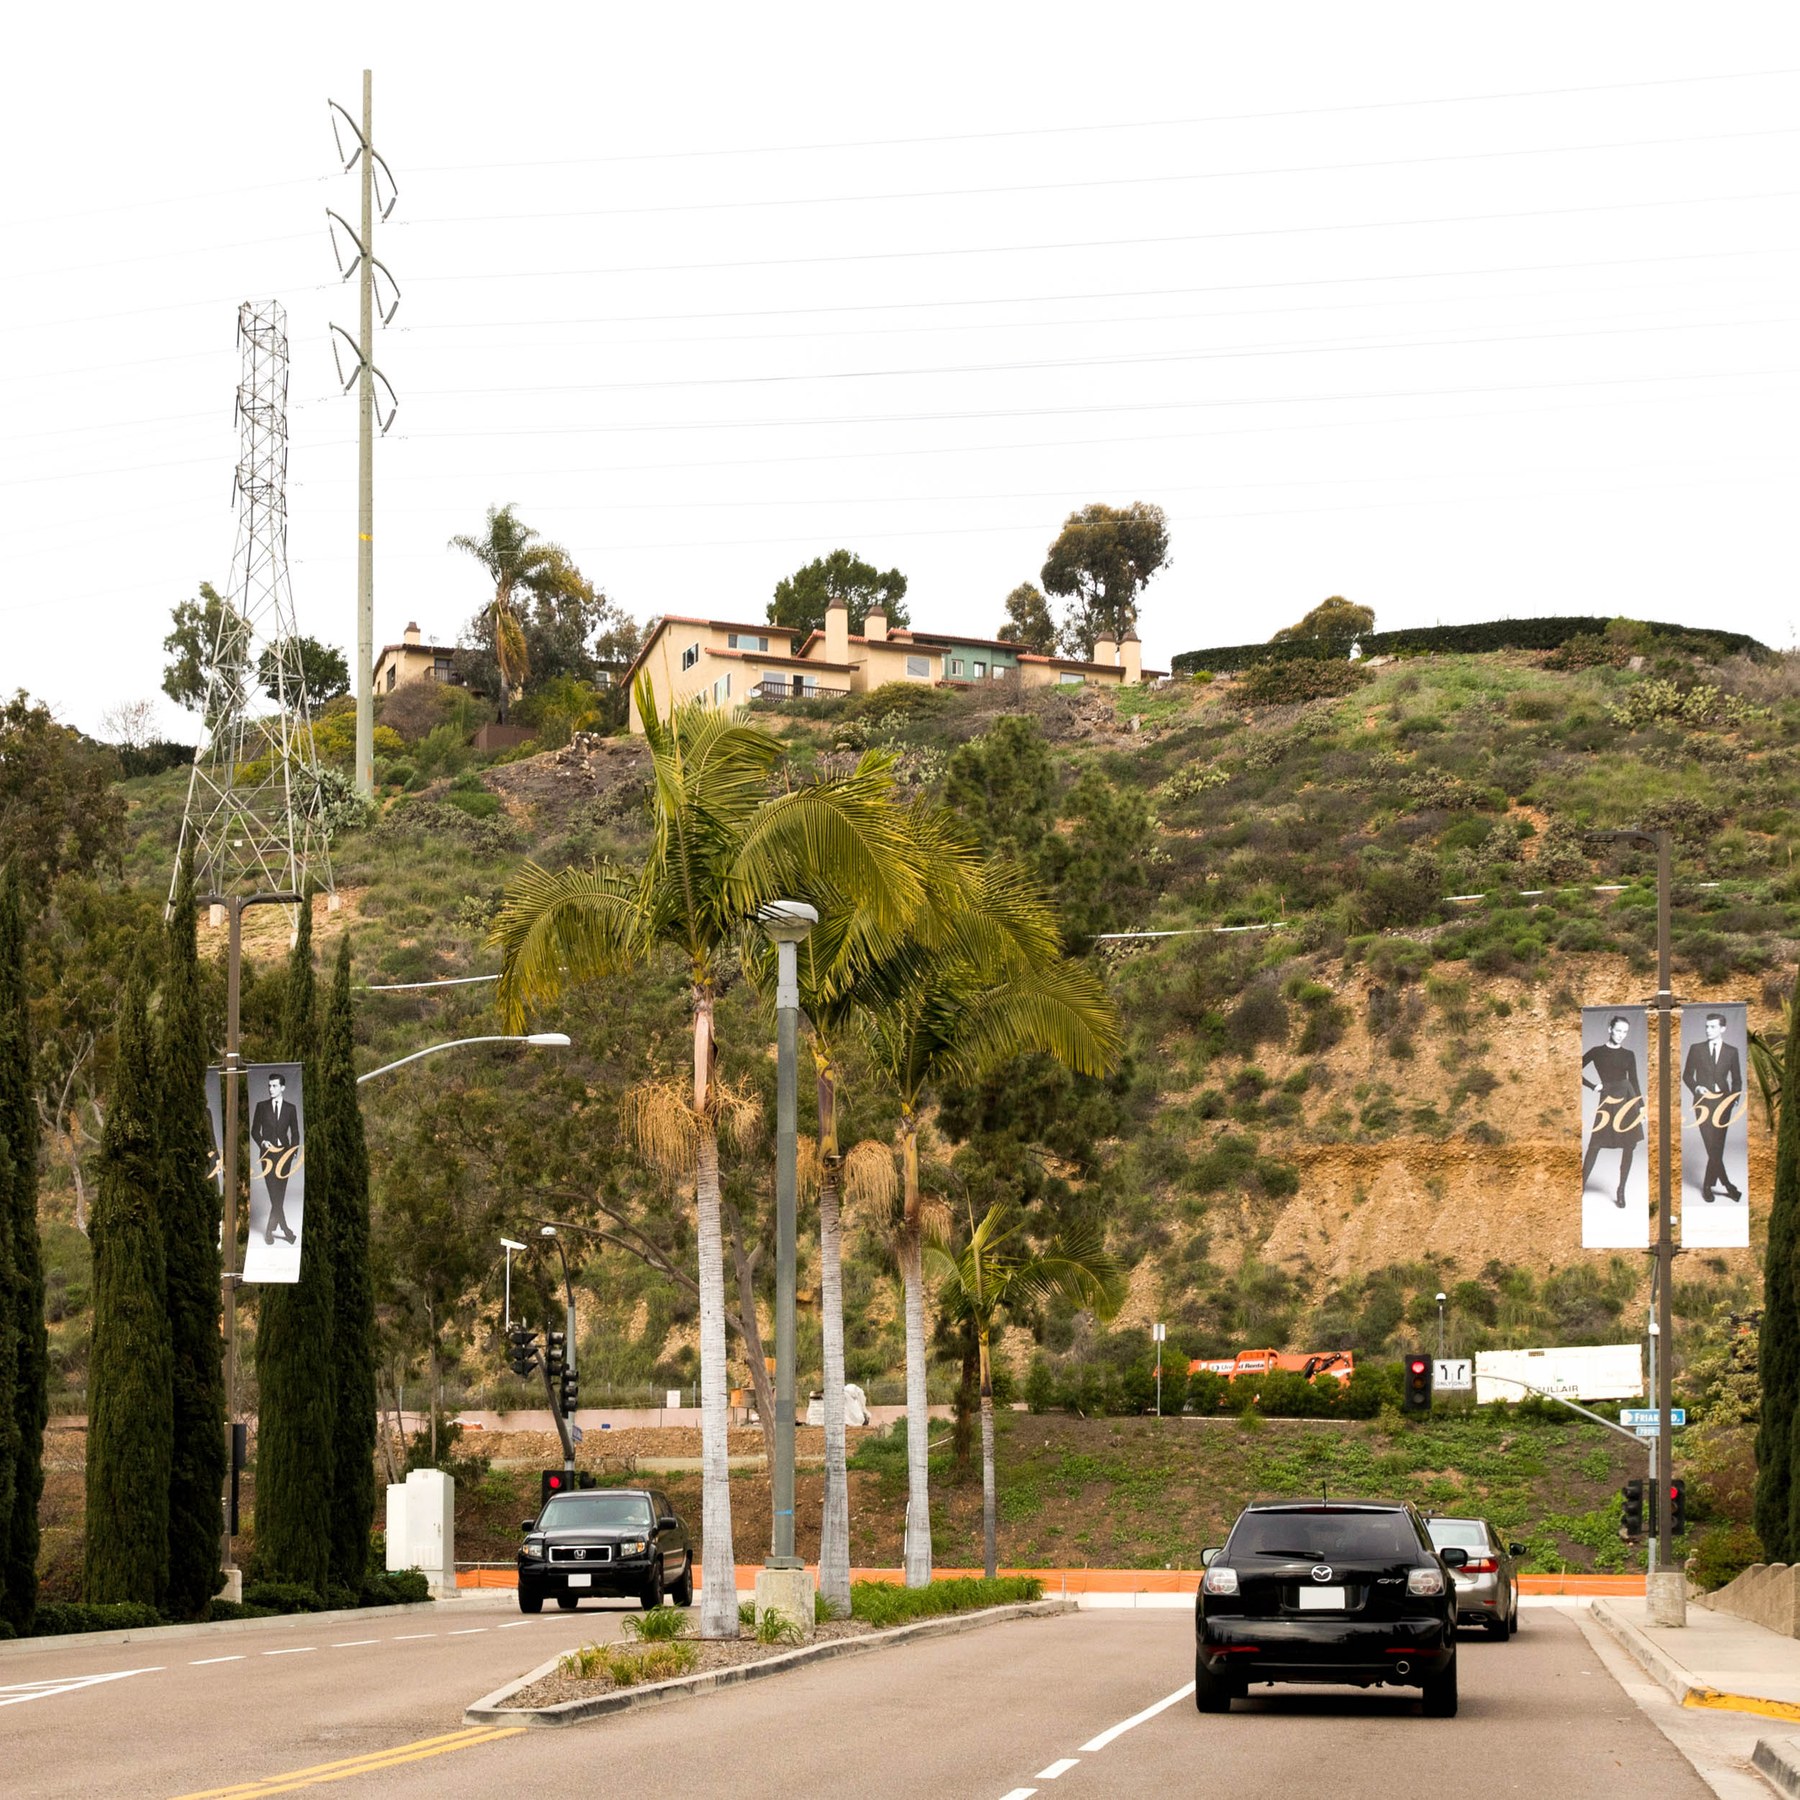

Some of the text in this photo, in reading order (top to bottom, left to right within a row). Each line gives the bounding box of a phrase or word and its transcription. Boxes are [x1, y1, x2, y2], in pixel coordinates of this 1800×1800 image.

[1586, 1094, 1647, 1133] 50
[1682, 1091, 1747, 1129] 50
[250, 1144, 305, 1180] 50
[1634, 1412, 1660, 1423] FRIAR
